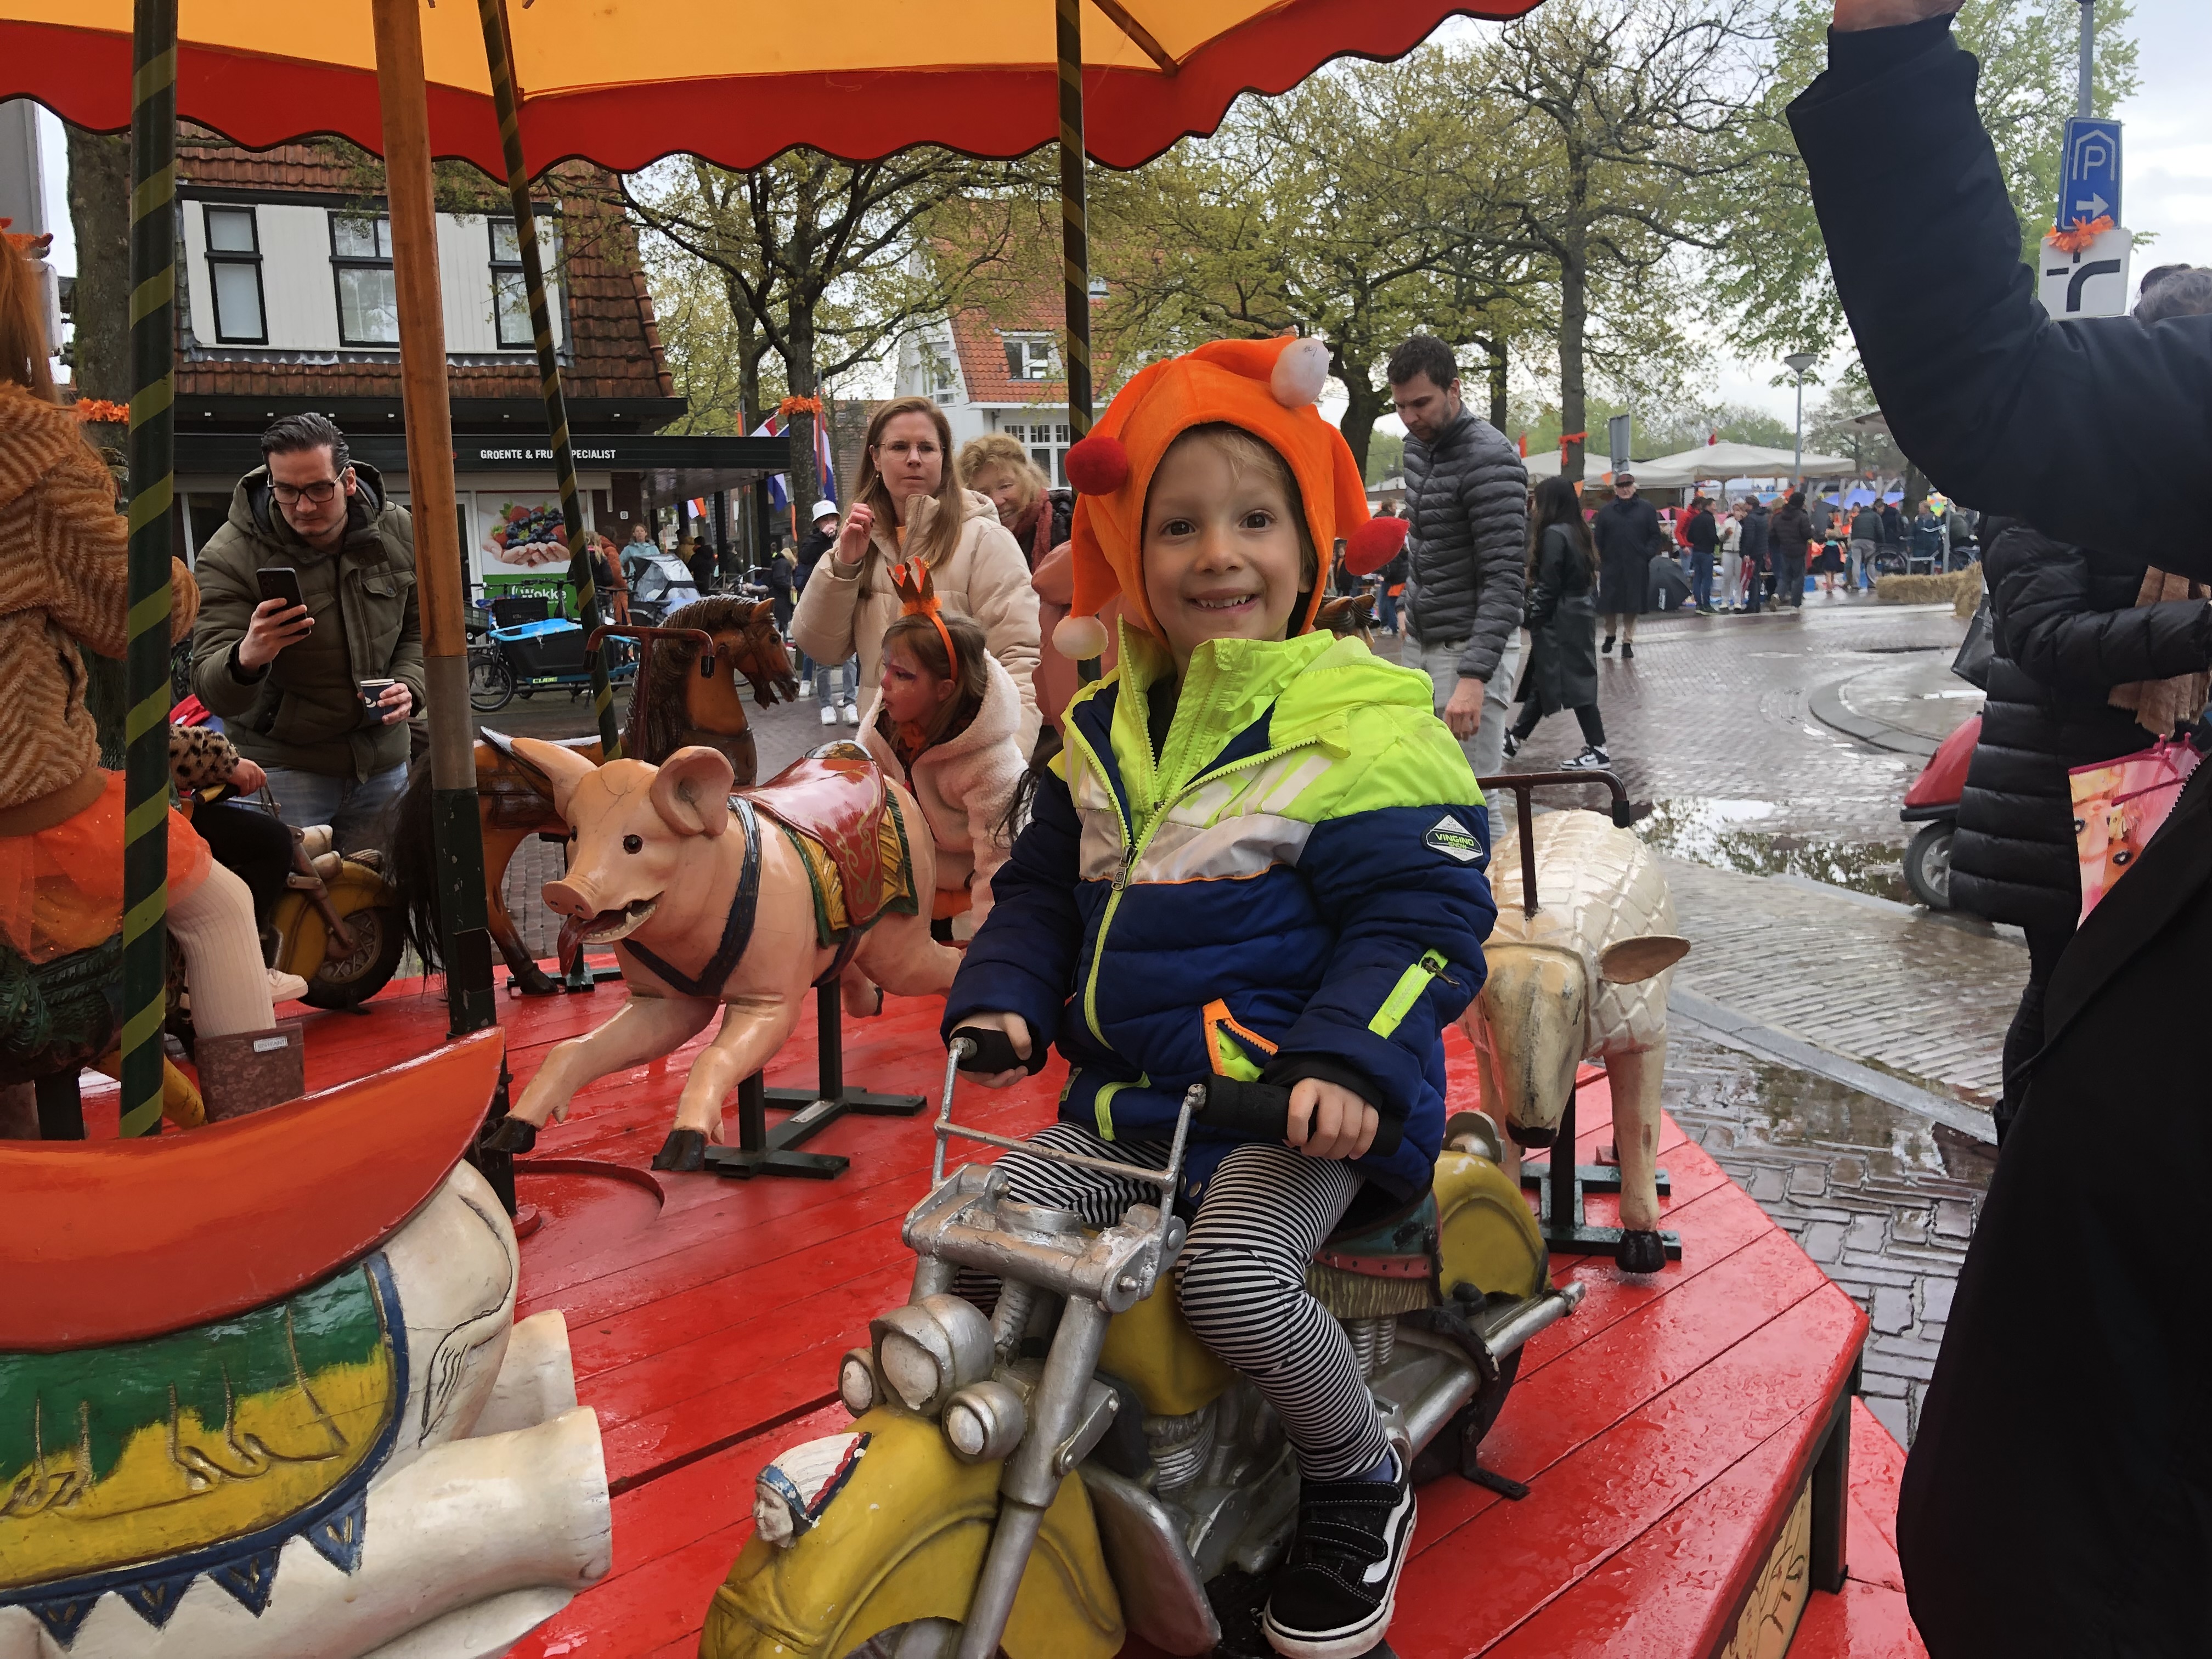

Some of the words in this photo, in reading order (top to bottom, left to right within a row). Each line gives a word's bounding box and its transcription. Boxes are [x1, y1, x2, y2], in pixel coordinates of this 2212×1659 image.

[2083, 145, 2107, 180] P
[481, 449, 522, 460] GROENTE
[525, 450, 533, 459] &
[535, 449, 554, 459] FRU
[571, 449, 616, 459] PECIALIST
[1435, 833, 1475, 847] VINGINO
